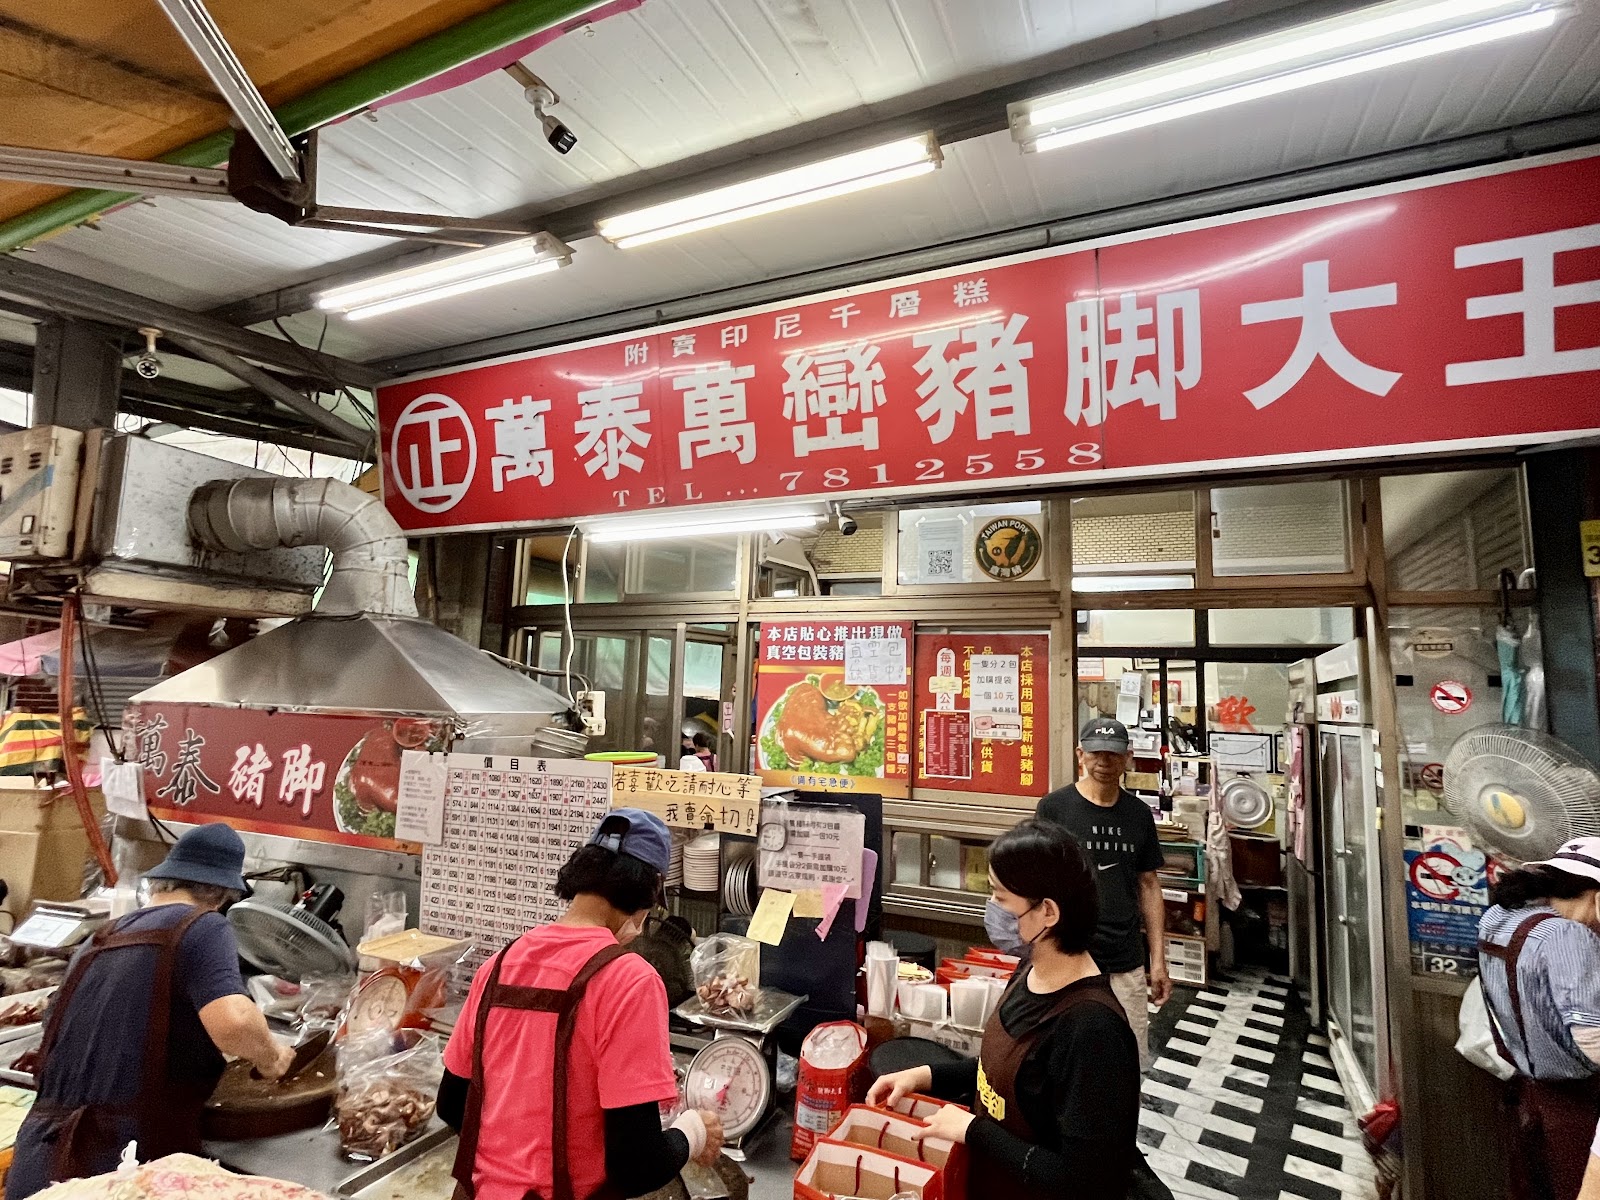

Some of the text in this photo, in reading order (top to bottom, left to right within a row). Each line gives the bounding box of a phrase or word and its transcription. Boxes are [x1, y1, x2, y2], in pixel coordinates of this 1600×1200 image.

[779, 442, 1102, 492] 7812558
[981, 519, 1008, 539] TAIWAN
[1009, 520, 1030, 535] PORK
[767, 626, 903, 642] 本店貼心推出現做
[1095, 727, 1115, 735] FILA
[614, 770, 753, 799] 若喜歡吃請耐心等
[1092, 825, 1122, 836] NIKE
[1086, 841, 1135, 853] UNNING
[1431, 957, 1458, 975] 32
